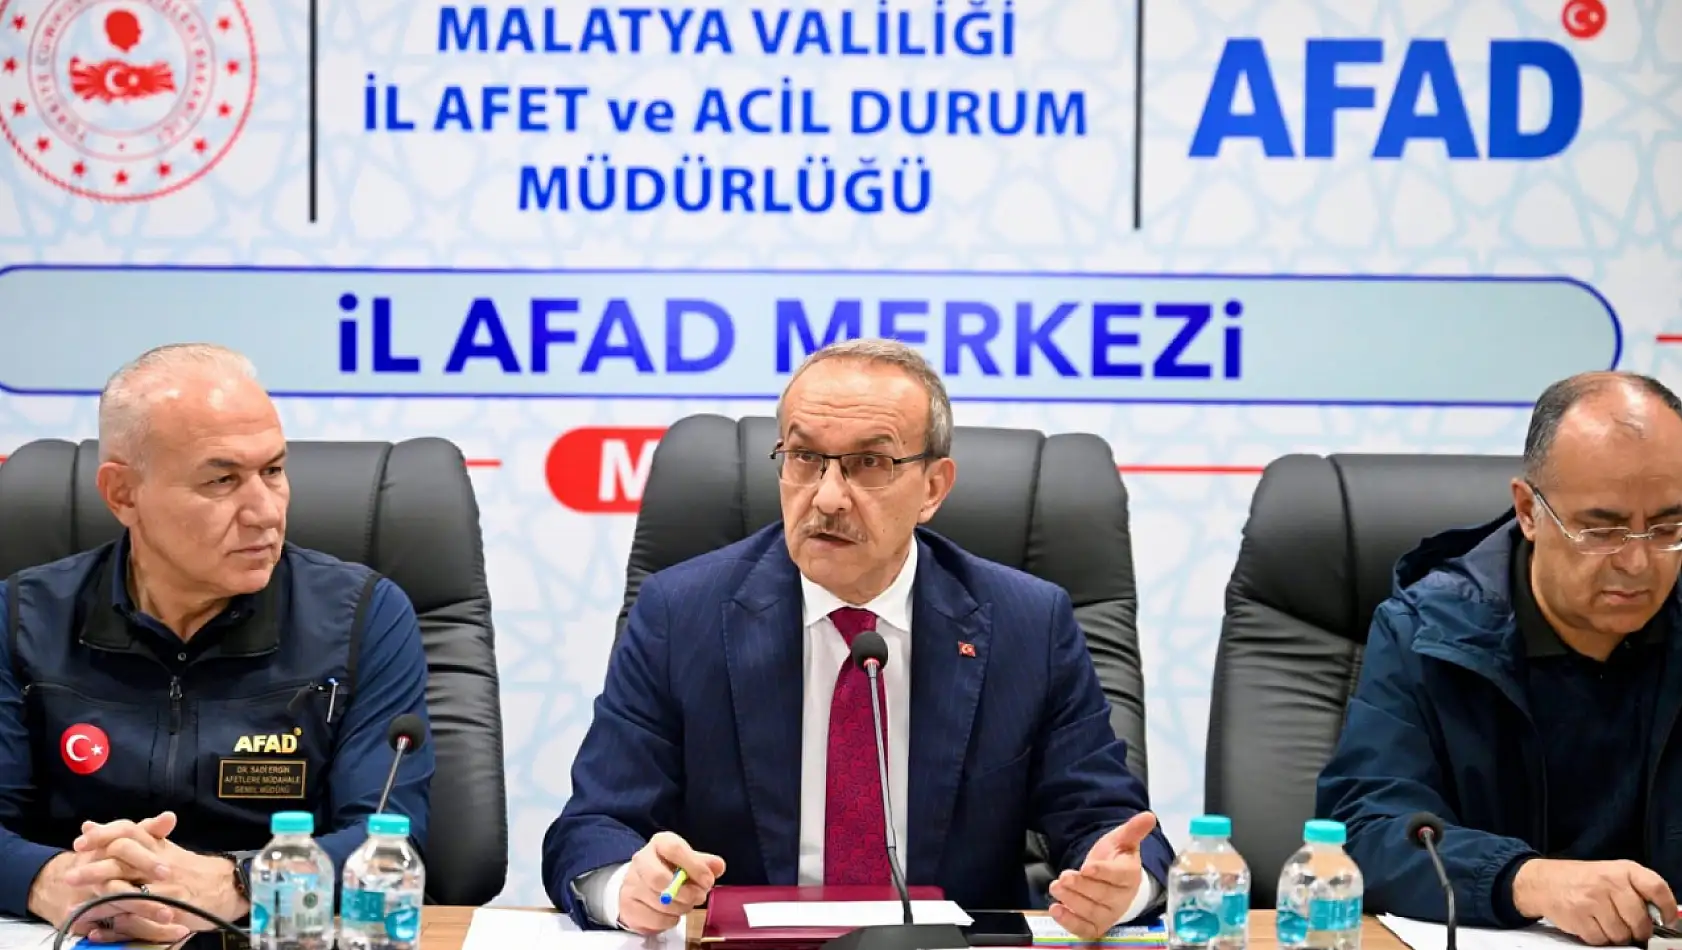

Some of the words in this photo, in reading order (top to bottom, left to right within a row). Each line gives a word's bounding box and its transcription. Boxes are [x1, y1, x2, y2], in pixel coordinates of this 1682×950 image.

[437, 5, 735, 56] MALATYA
[751, 0, 1016, 58] VALİLİĞİ
[364, 73, 417, 134] İL
[433, 84, 591, 134] AFET
[607, 98, 676, 136] ve
[692, 76, 832, 136] ACİL
[851, 88, 1088, 138] DURUM
[1188, 37, 1584, 162] AFAD
[518, 153, 933, 216] MÜDÜRLÜĞÜ
[443, 296, 737, 376] AFAD
[233, 734, 298, 754] AFAD
